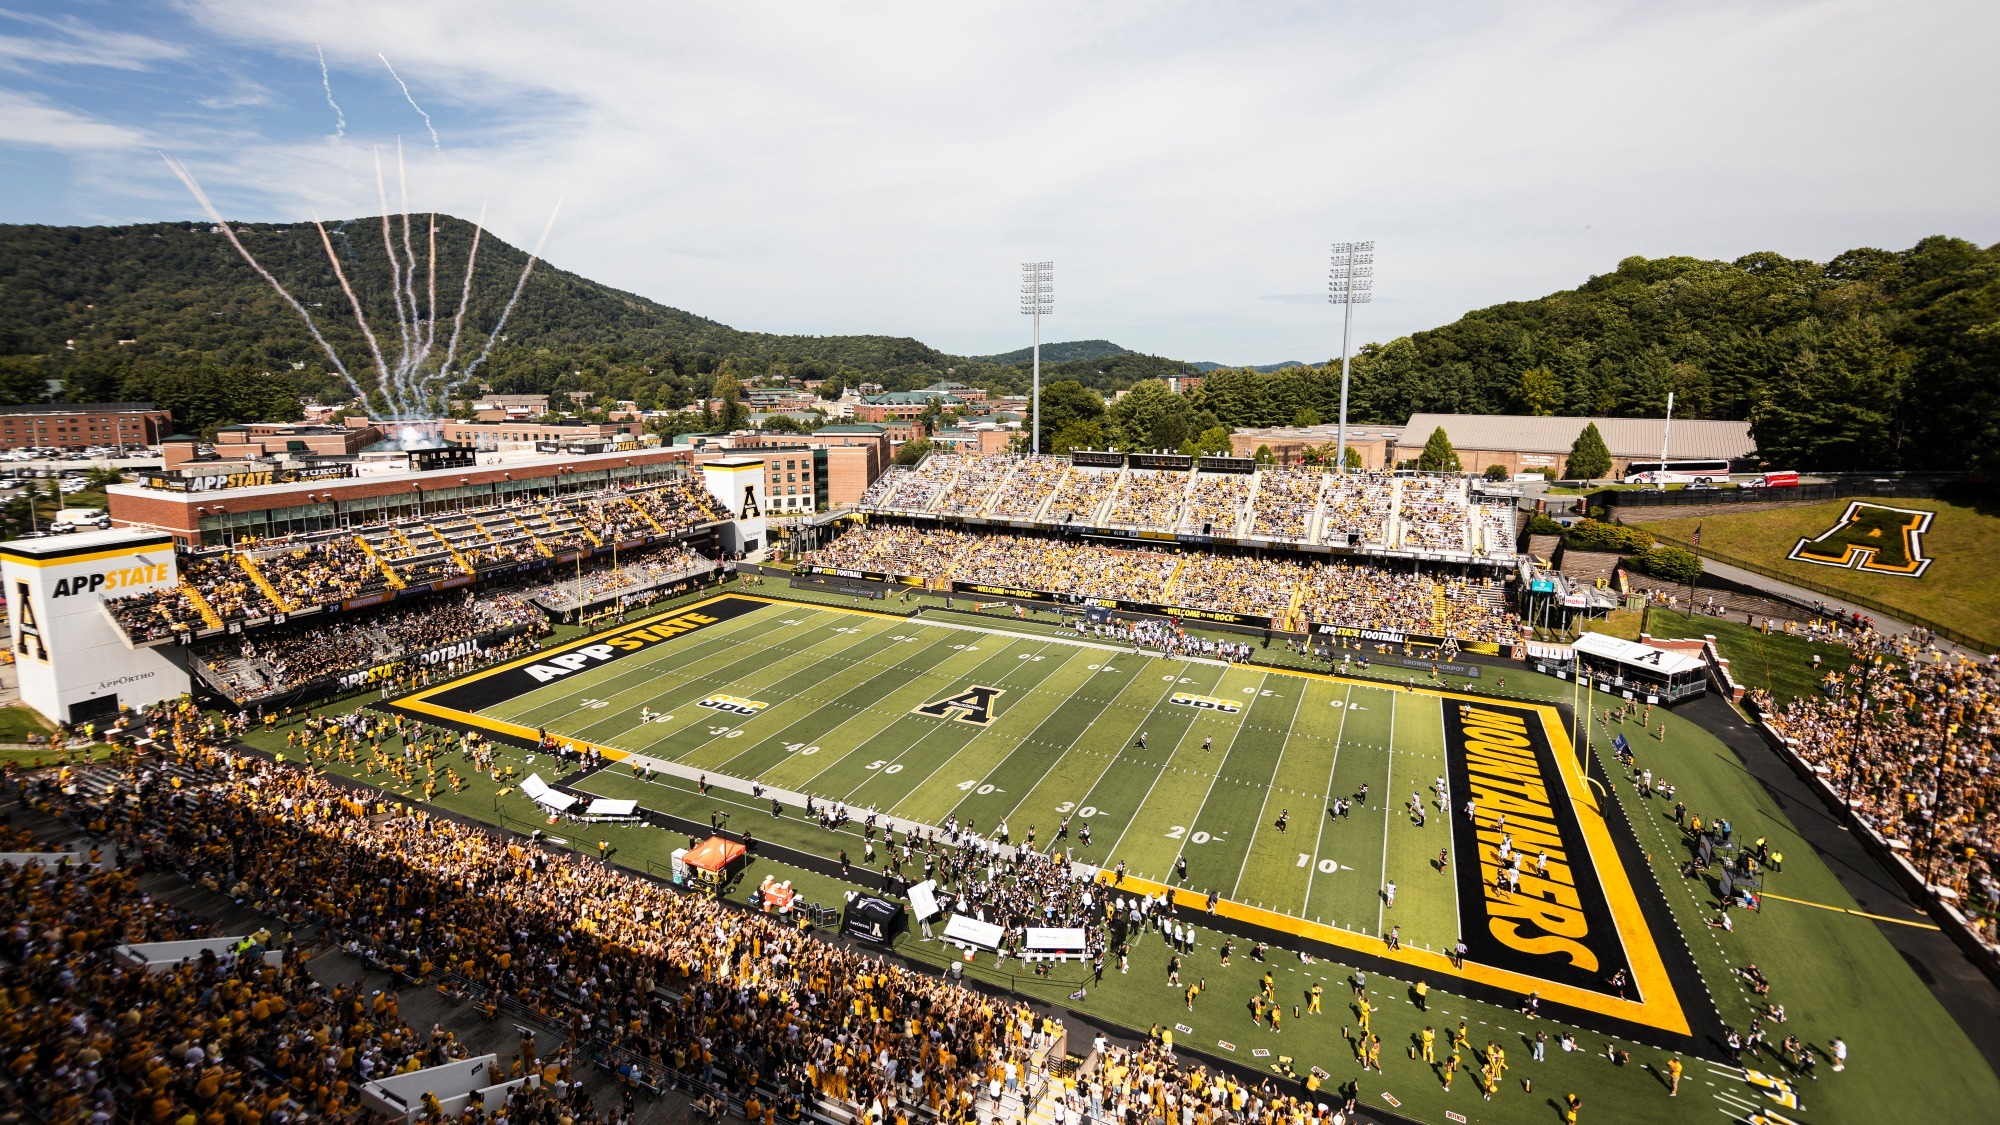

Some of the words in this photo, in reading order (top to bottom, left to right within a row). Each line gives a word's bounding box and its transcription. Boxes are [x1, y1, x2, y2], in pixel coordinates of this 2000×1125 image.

[602, 440, 637, 453] APPSTATE
[191, 471, 273, 492] APPSTATE
[740, 485, 761, 521] A
[1785, 501, 1937, 579] A
[812, 566, 823, 574] APP
[822, 567, 837, 576] STATE
[837, 569, 863, 579] FOOTBALL
[52, 563, 169, 599] APPSTATE
[976, 584, 1005, 595] WELCOME
[1015, 590, 1032, 599] ROCK
[1084, 597, 1117, 609] APPSTATE
[14, 577, 50, 666] A
[1167, 607, 1201, 618] WELCOME
[1214, 612, 1235, 622] ROCK
[1318, 625, 1336, 636] APP
[1336, 627, 1360, 639] STATE
[1360, 630, 1404, 643] FOOTBALL
[523, 612, 719, 683] APPSTATE
[1402, 659, 1433, 668] GROWING
[1633, 650, 1665, 666] A
[1242, 687, 1277, 697] 20
[910, 684, 1007, 727] A
[1329, 700, 1359, 711] 10
[709, 725, 744, 739] 30
[785, 742, 821, 756] 40
[864, 759, 904, 775] 50
[956, 779, 995, 795] 40
[1054, 801, 1098, 818] 30
[1163, 825, 1211, 845] 20
[1459, 704, 1599, 973] MOUNTAINEERS
[1296, 852, 1339, 874] 10
[871, 922, 883, 938] A
[1447, 1111, 1466, 1122] DEFENSE
